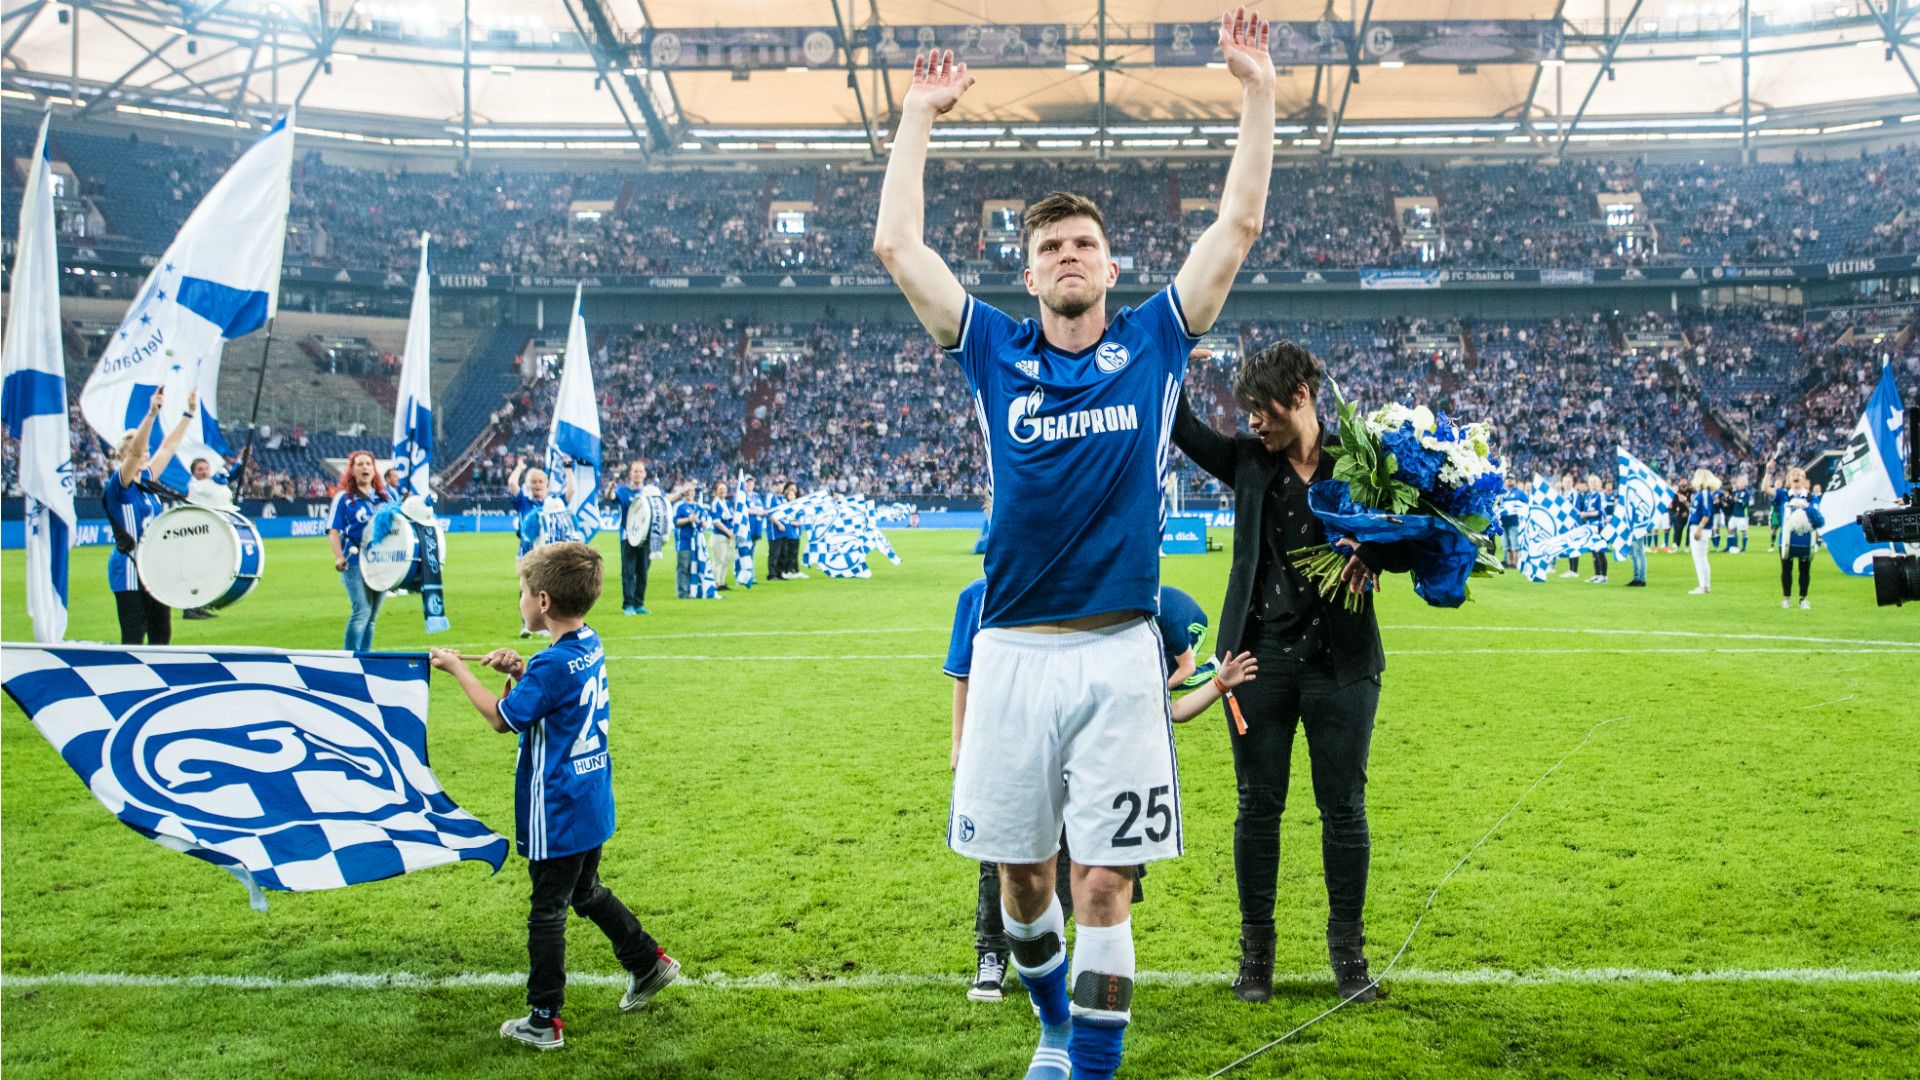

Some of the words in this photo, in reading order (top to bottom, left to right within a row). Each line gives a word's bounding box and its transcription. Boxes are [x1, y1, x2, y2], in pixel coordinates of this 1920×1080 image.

[1772, 267, 1796, 277] dich.
[1827, 258, 1876, 275] VELTINS
[439, 275, 488, 288] VELTINS
[1152, 275, 1168, 284] Wir
[1452, 271, 1463, 280] FC
[1466, 271, 1501, 280] Schalke
[1503, 271, 1515, 280] 04
[1043, 404, 1138, 442] GAZPROM
[173, 524, 210, 538] SONOR
[567, 657, 585, 674] FC
[1111, 785, 1172, 848] 25
